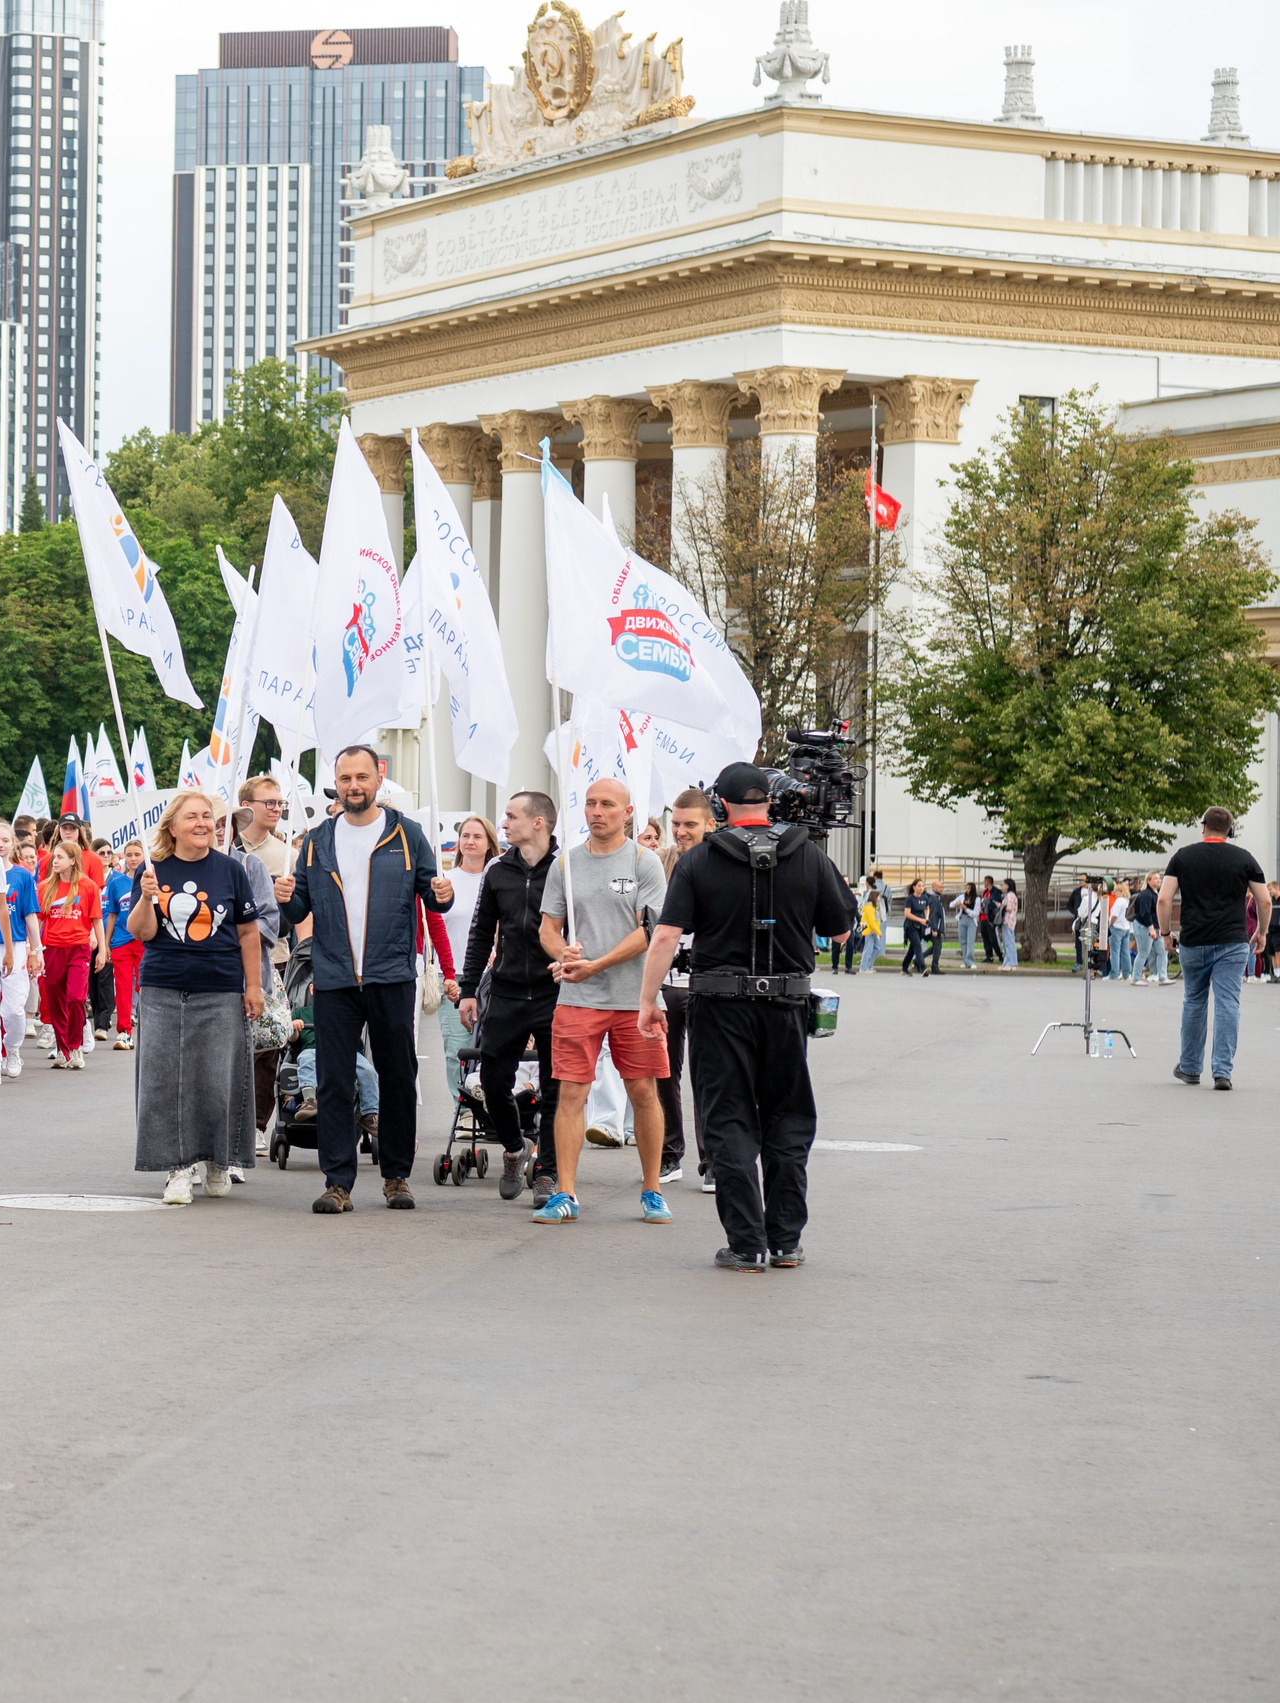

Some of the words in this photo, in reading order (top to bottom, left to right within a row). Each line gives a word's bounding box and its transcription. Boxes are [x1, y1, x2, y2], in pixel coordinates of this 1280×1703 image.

[436, 218, 529, 257] СОВЕТСКАЯ
[537, 182, 679, 231] ФЕДЕРАТИВНАЯ
[467, 171, 638, 230] РОССИЙСКАЯ
[436, 230, 577, 277] СОЦИАЛИСТИЧЕСКАЯ
[584, 204, 680, 244] РЕСПУБЛИКА
[359, 547, 393, 574] ИЙСКОЕ
[616, 632, 691, 677] СЕМЬЯ
